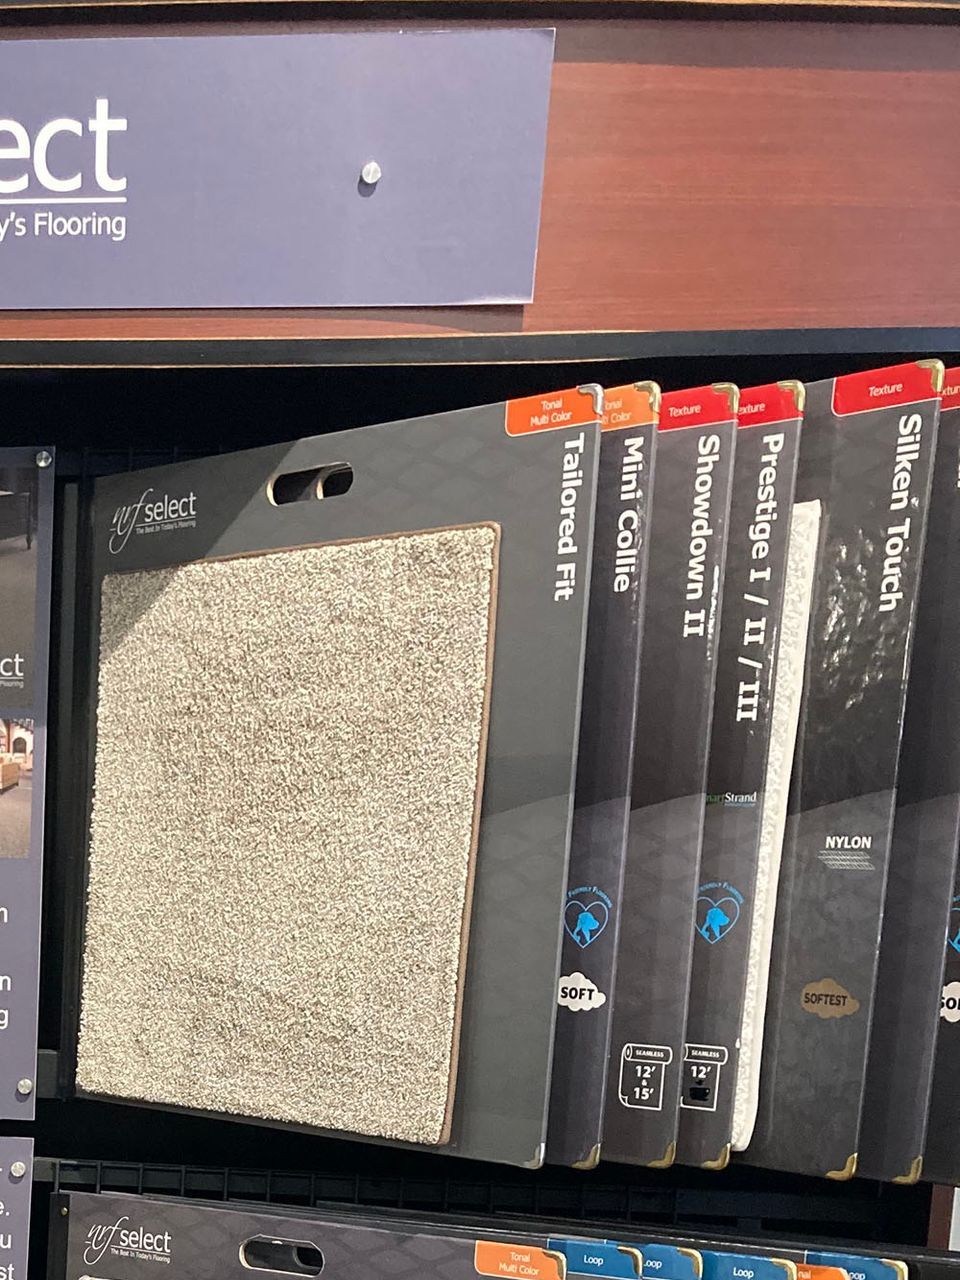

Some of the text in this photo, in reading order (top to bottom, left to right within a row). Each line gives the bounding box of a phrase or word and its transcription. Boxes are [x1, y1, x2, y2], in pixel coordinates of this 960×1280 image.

[33, 212, 127, 242] Flooring
[868, 383, 903, 397] Texture
[541, 398, 563, 410] Tonal
[604, 398, 623, 411] onal
[668, 404, 701, 418] Texture
[738, 402, 766, 415] exture
[530, 411, 572, 427] Multi Color
[610, 411, 632, 424] Color
[144, 492, 197, 522] select
[878, 412, 922, 613] Silken Touch
[554, 433, 584, 602] Tailored Fit
[614, 436, 645, 594] Mini Collie
[682, 434, 720, 638] Showdown II
[736, 432, 785, 722] Prestige I / II / III
[825, 836, 872, 849] NYLON
[560, 986, 595, 1001] SOFT
[804, 991, 848, 1007] SOFTEST
[635, 1065, 656, 1078] 12'
[690, 1065, 711, 1079] 12'
[634, 1087, 654, 1100] 15'
[83, 1216, 172, 1265] nrf select
[510, 1251, 531, 1263] Tonal
[583, 1254, 604, 1267] Loop
[499, 1262, 539, 1276] Multi Color
[644, 1260, 663, 1270] oop
[733, 1267, 754, 1280] Loop
[798, 1270, 811, 1279] nal
